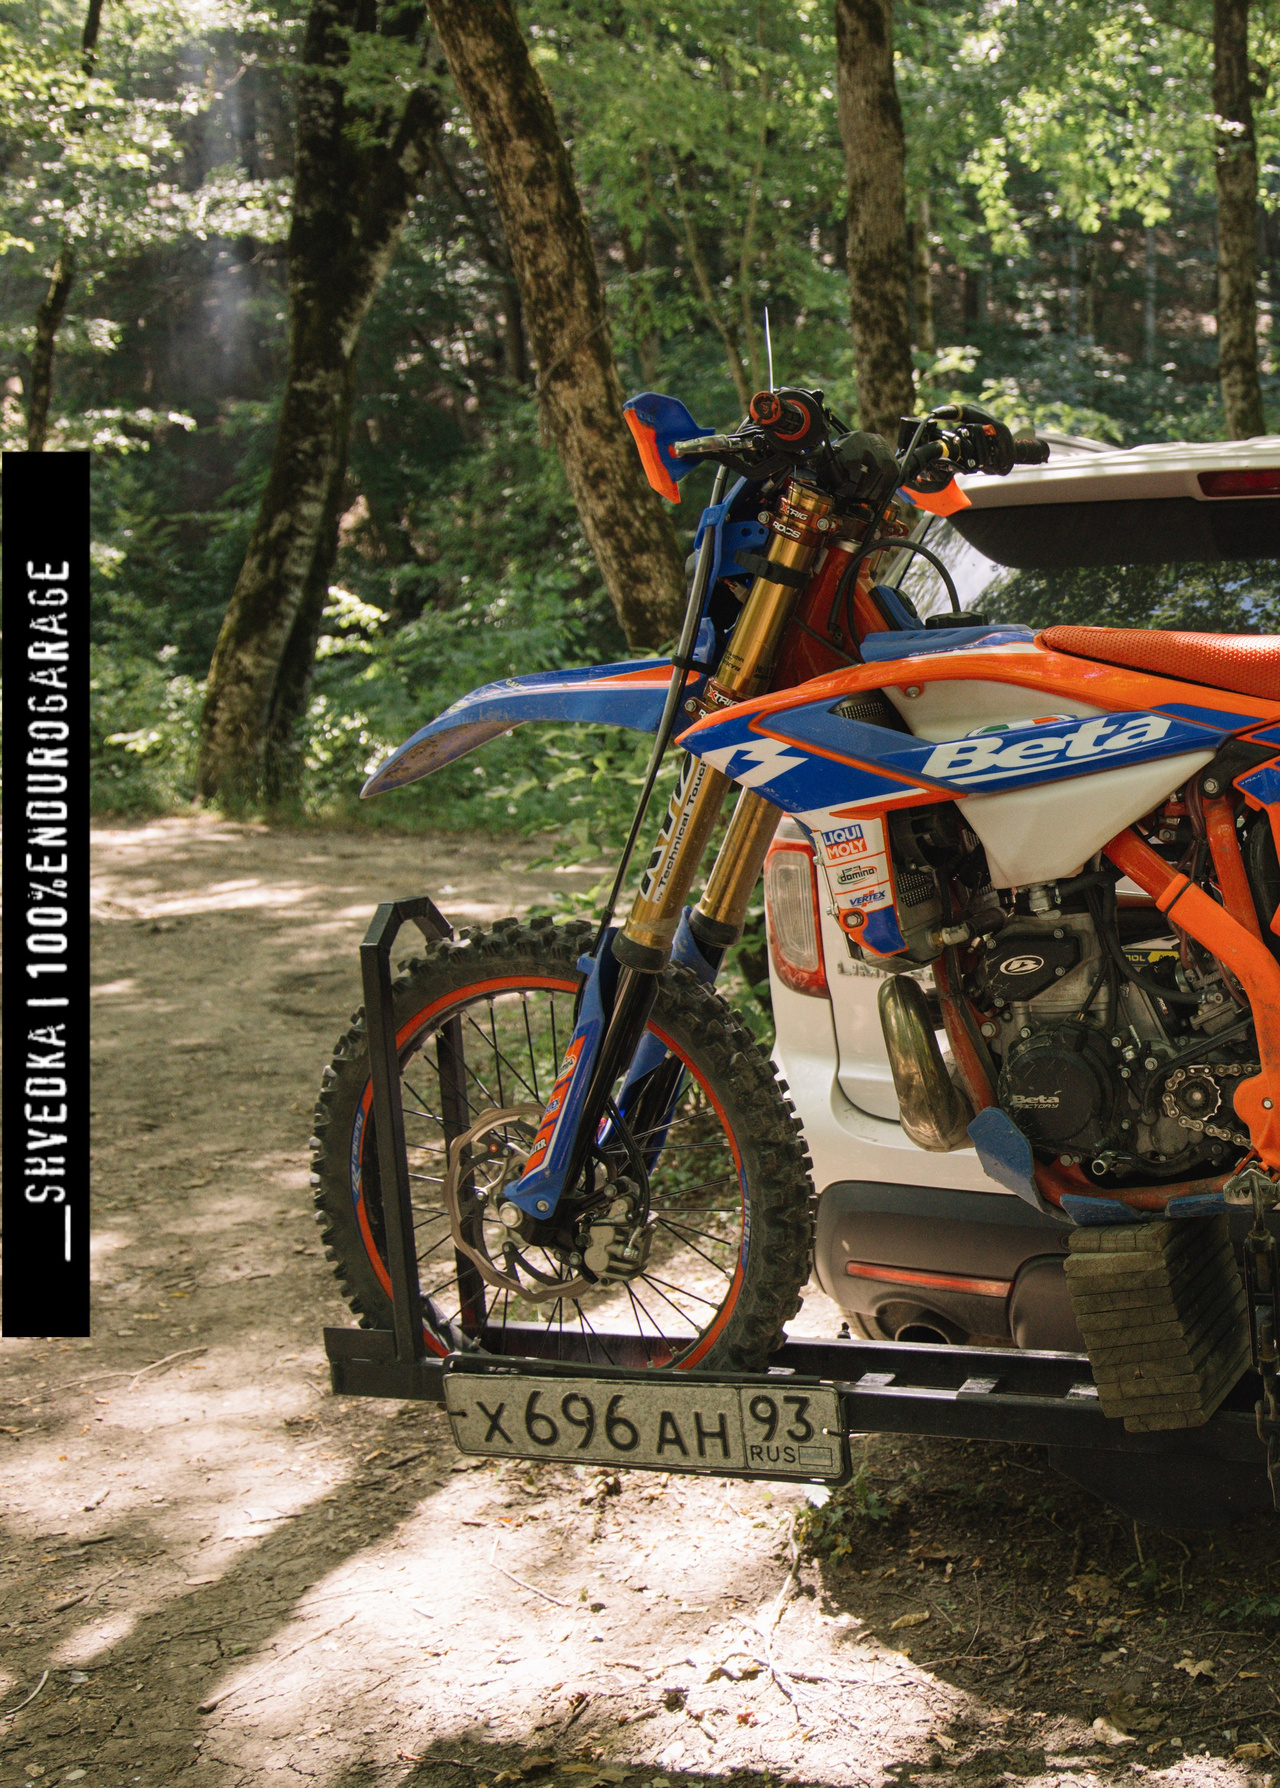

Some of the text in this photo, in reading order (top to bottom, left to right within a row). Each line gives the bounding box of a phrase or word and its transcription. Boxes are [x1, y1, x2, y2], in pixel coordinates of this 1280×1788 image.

[921, 714, 1172, 777] Beta
[823, 825, 863, 846] LIQUI
[658, 812, 690, 889] Technical
[826, 839, 865, 859] MOLY
[840, 867, 876, 882] domino
[849, 890, 886, 907] VERTEX
[1012, 1094, 1060, 1104] Beta
[749, 1444, 797, 1464] RUS
